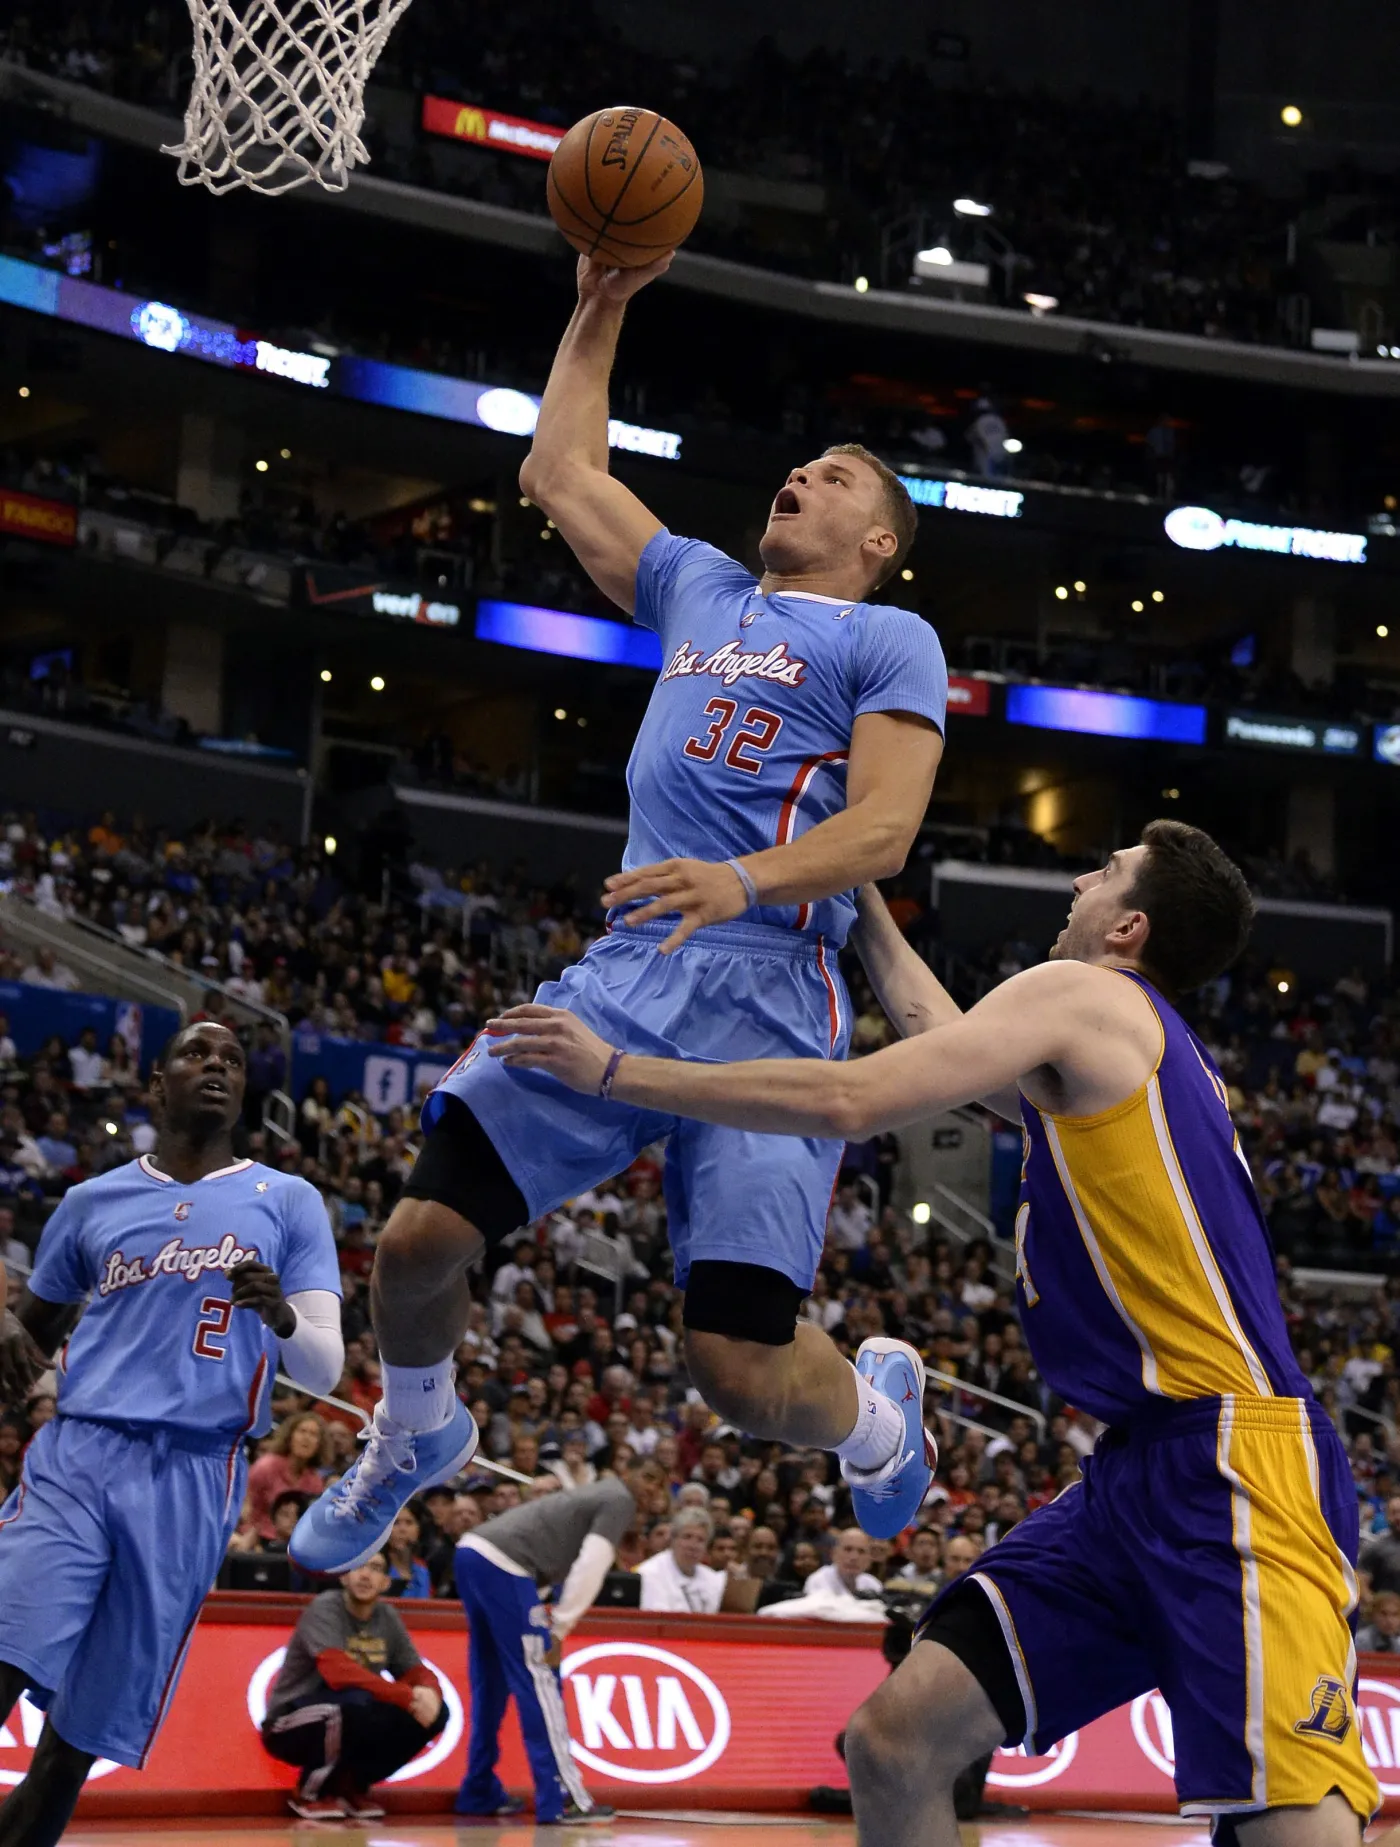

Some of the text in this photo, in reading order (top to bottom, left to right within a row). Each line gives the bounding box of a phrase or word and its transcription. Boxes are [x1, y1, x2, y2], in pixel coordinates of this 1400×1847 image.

[602, 109, 644, 170] SPALD
[661, 639, 807, 688] Los Angeles
[683, 697, 783, 775] 32
[100, 1250, 147, 1297] Los
[193, 1296, 234, 1360] 2
[569, 1673, 707, 1750] KIA
